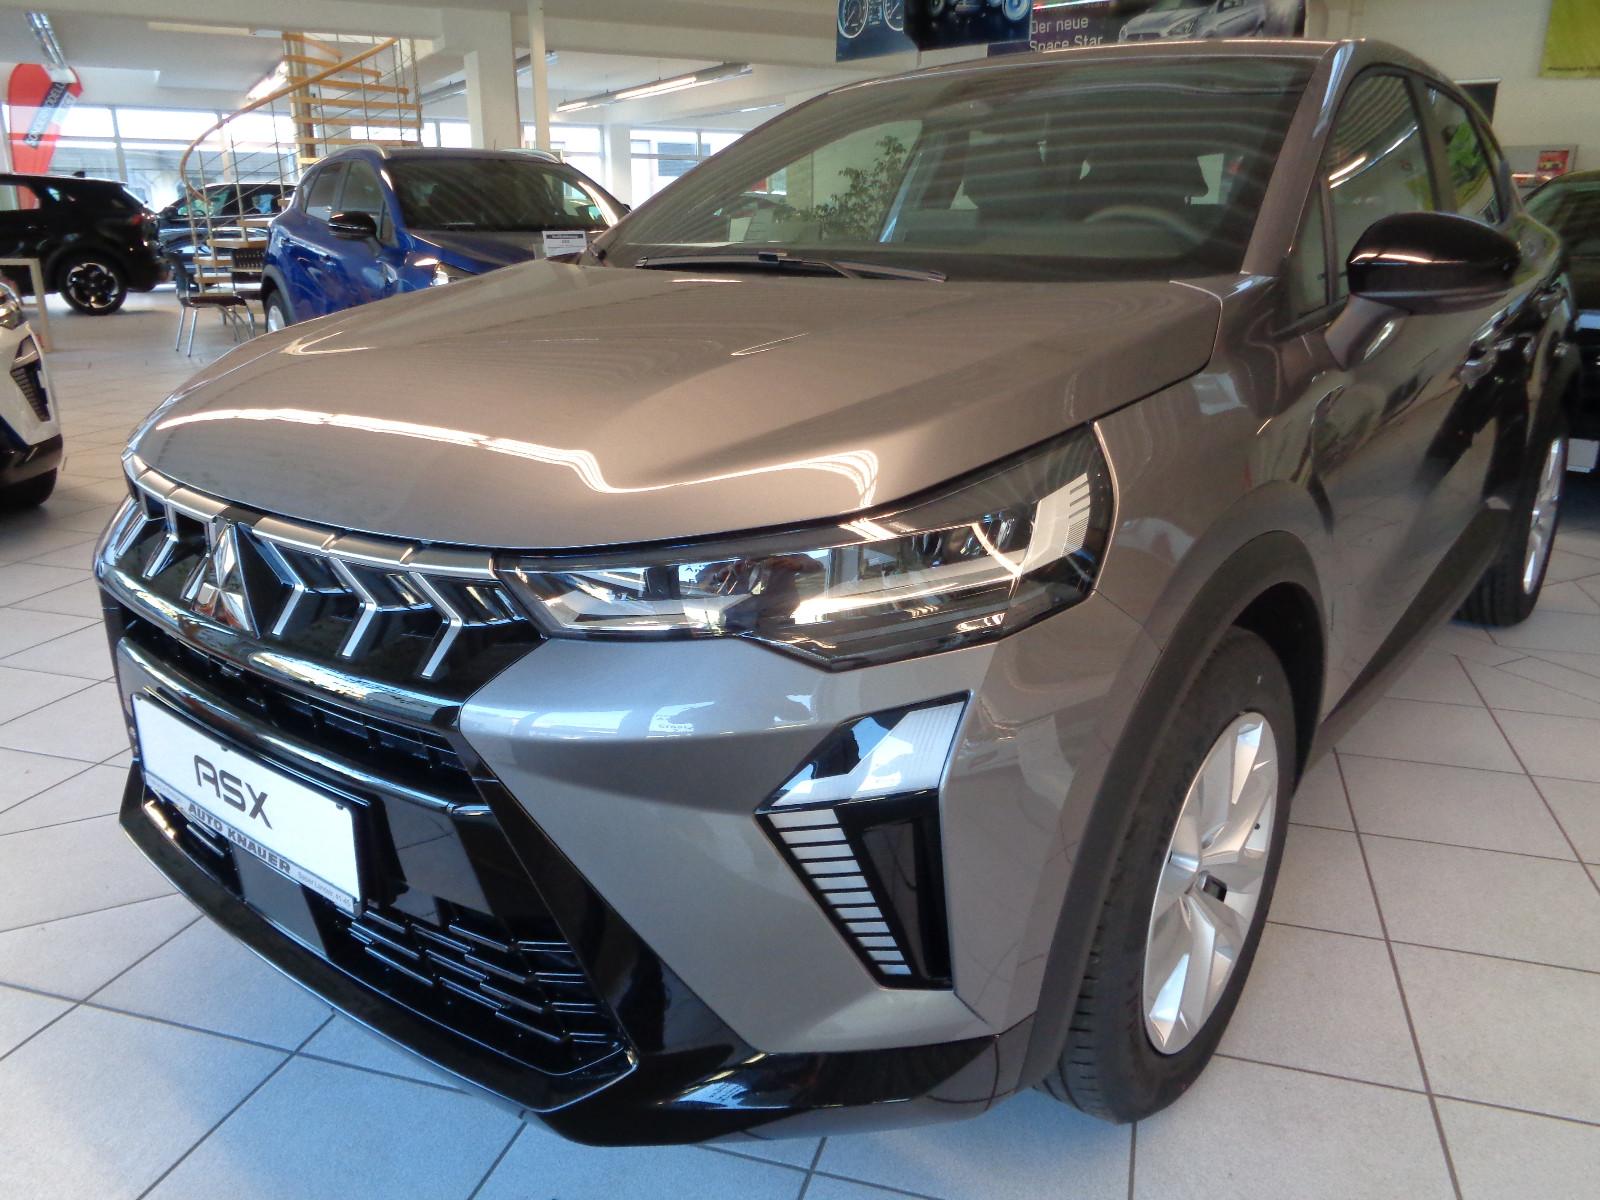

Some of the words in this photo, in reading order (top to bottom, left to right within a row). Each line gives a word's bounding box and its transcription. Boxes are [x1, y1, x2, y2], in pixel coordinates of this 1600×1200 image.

[1031, 21, 1051, 34] Der
[1056, 17, 1089, 32] neue
[1074, 34, 1104, 47] Star
[193, 754, 273, 830] ASX
[189, 803, 223, 832] AUTO
[227, 827, 291, 875] KNAUER
